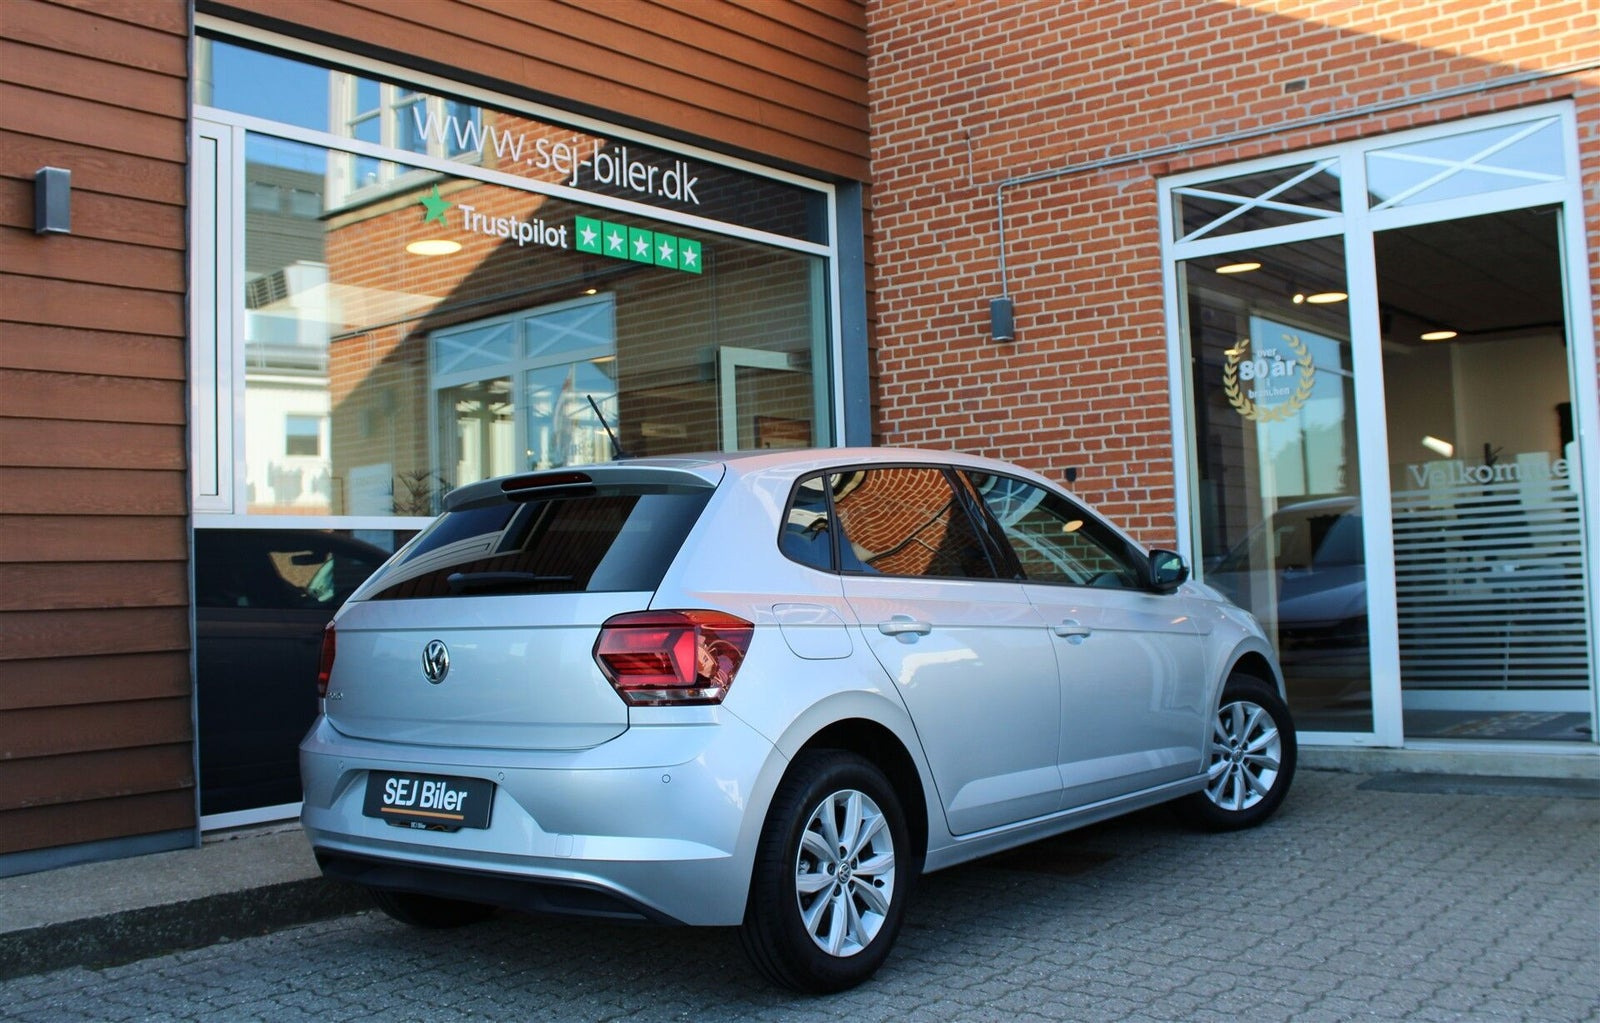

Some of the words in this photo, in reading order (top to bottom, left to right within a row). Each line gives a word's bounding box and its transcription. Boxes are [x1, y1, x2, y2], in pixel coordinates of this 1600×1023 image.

[412, 105, 700, 205] www.sej-biler.dk
[458, 203, 568, 249] Trustpilot
[1240, 360, 1268, 380] 80
[1272, 355, 1296, 377] år
[383, 778, 419, 806] SEJ
[419, 781, 467, 811] Biler
